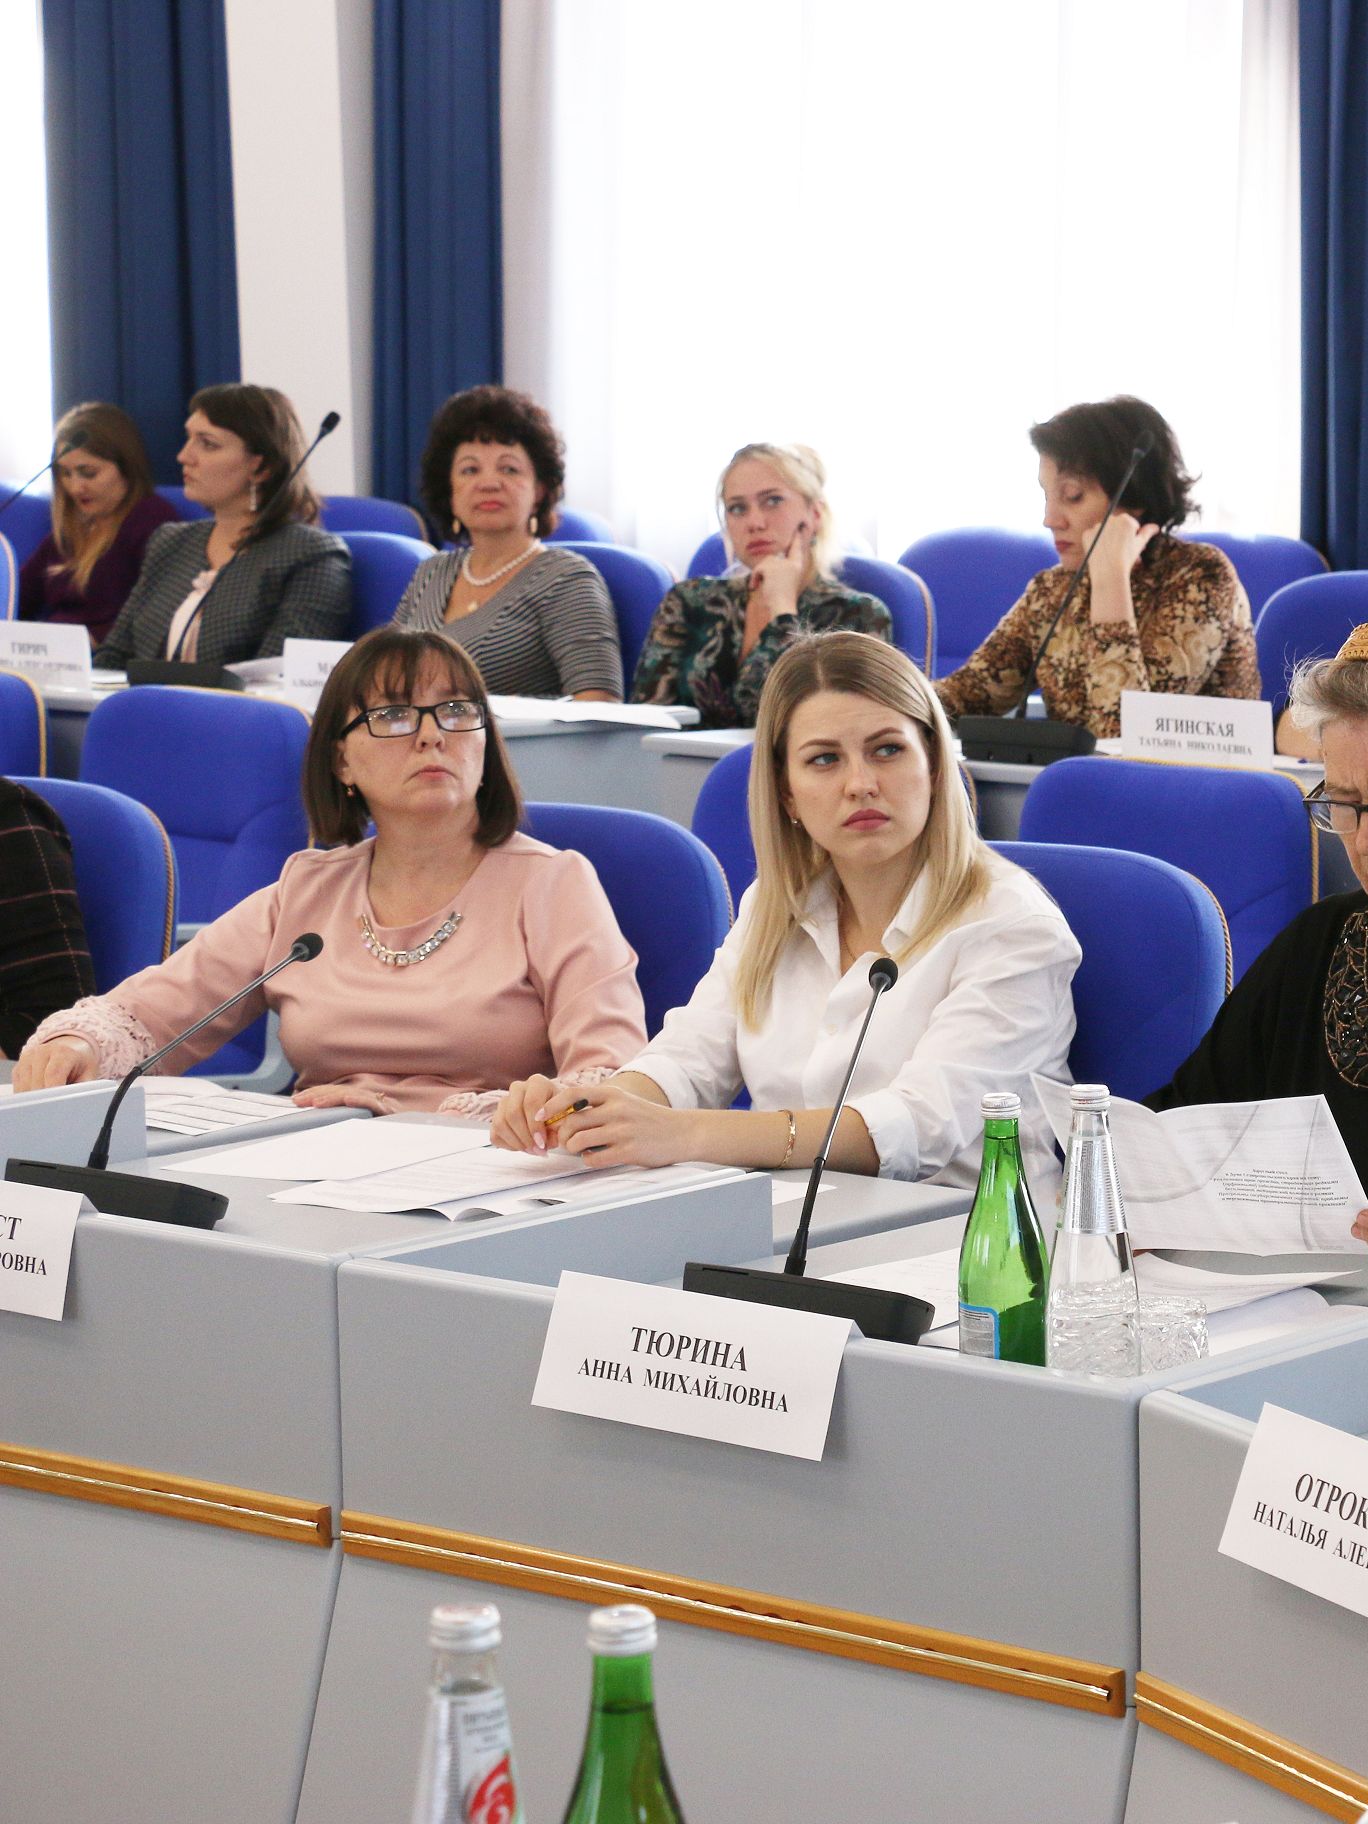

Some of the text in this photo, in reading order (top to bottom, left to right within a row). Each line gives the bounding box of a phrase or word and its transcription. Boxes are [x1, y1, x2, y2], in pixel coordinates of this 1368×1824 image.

[1155, 717, 1235, 738] ЯГИНСКАЯ
[0, 1252, 47, 1276] ОВНА
[631, 1326, 748, 1372] ТЮРИНА
[577, 1357, 789, 1413] АННА МИХАЙЛОВНА
[1252, 1501, 1329, 1551] НАТАЛЬЯ
